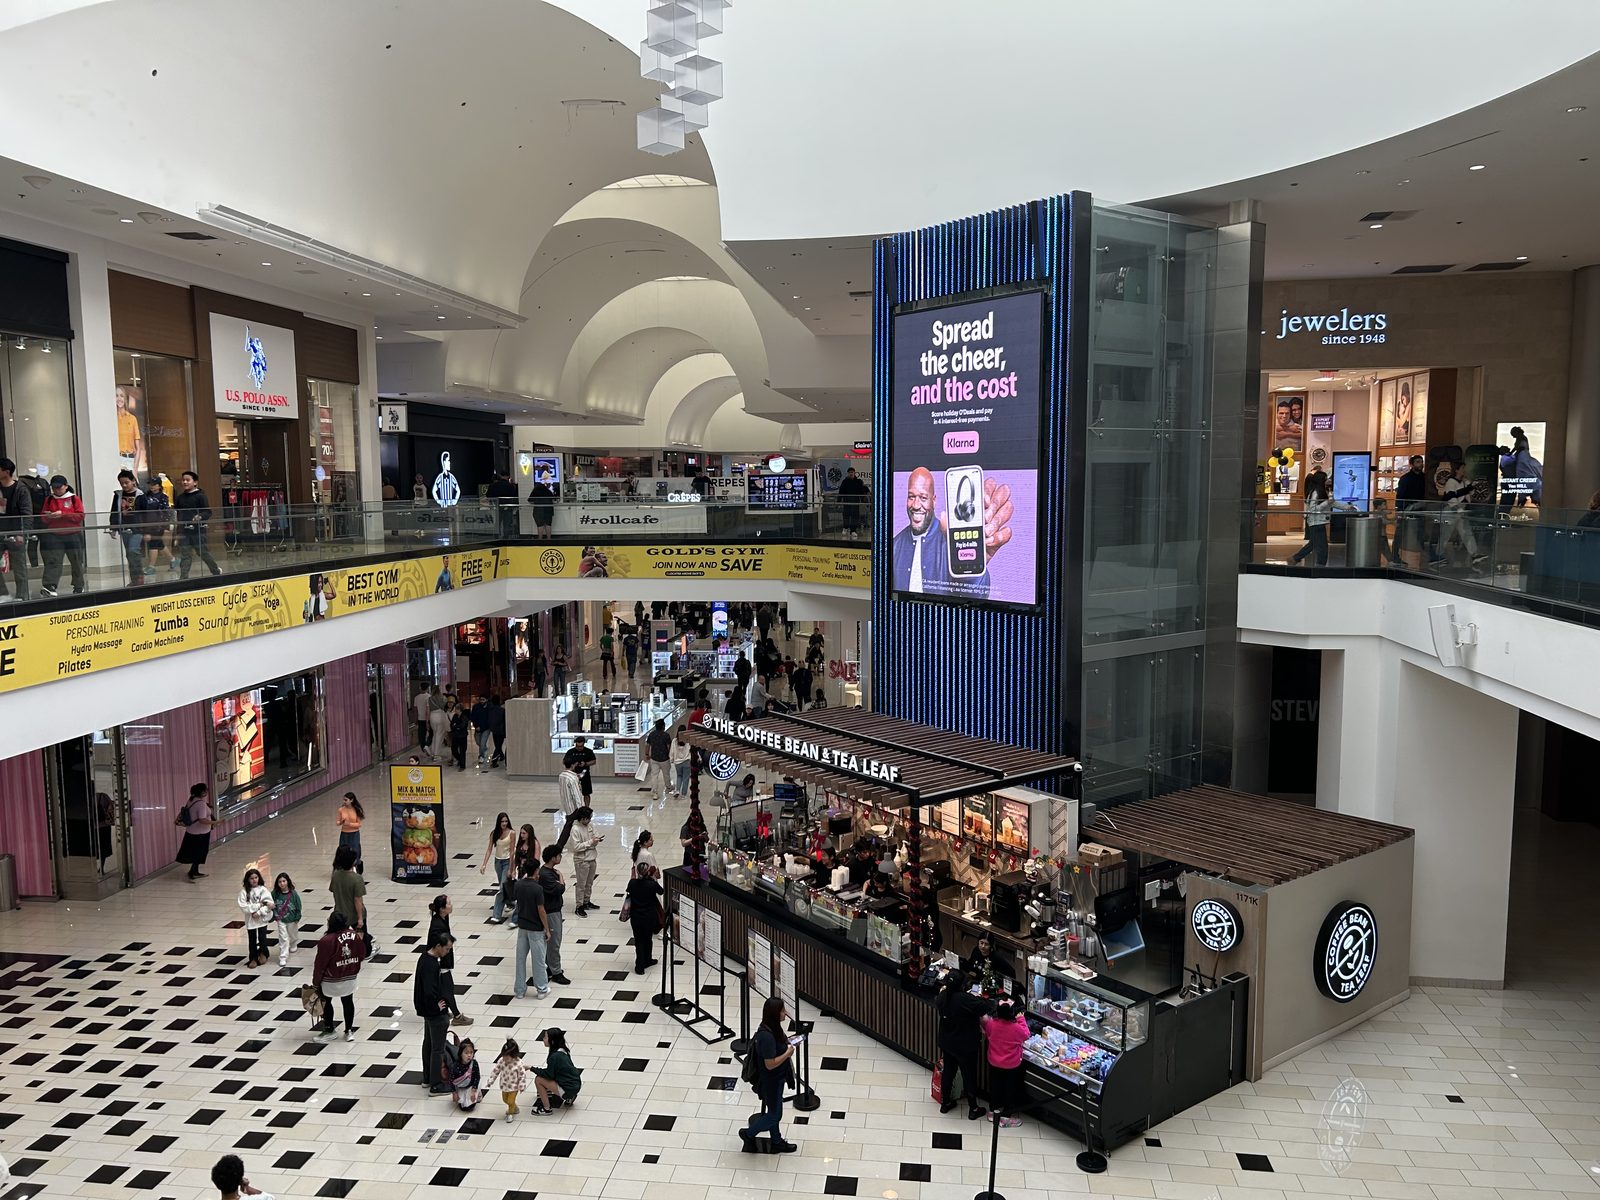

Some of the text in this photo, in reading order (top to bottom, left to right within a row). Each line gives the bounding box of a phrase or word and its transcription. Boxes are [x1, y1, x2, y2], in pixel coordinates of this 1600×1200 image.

[932, 311, 994, 350] Spread
[1276, 308, 1387, 339] jewelers
[1322, 334, 1386, 345] since 1948
[920, 345, 1006, 376] the cheer,
[911, 372, 1018, 405] and the cost
[225, 390, 290, 407] U.S. POLO ASSN.
[242, 404, 260, 412] SINCE
[947, 438, 975, 448] Klarna
[711, 478, 745, 487] REPES
[580, 515, 659, 525] #rollcafe
[647, 547, 765, 555] GOLD'S GYM
[462, 558, 482, 578] FREE
[491, 549, 500, 579] 7
[652, 559, 763, 571] JOIN NOW AND SAVE
[835, 562, 856, 571] Zumba
[348, 569, 398, 591] BEST GYM
[253, 584, 275, 597] STEAM
[348, 587, 399, 607] IN THE WORLD
[151, 596, 215, 613] WEIGHT LOSS CENTER
[223, 589, 247, 610] Cycle
[264, 597, 280, 610] Yoga
[49, 610, 100, 626] STUDIO CLASSES
[154, 615, 189, 633] Zumba
[198, 616, 229, 631] Sauna
[66, 616, 145, 641] PERSONAL TRAINING
[71, 638, 123, 657] Hydro Massage
[131, 634, 184, 653] Cardio Machines
[58, 659, 91, 675] Pilates
[713, 717, 899, 782] THE COFFEE BEAN & TEA LEAF
[1236, 893, 1258, 906] 1171K
[1195, 904, 1229, 923] COFFEE BEAN
[337, 931, 356, 944] EDEN
[1206, 937, 1219, 947] TEA
[1329, 913, 1368, 966] COFFEE BEAN
[1341, 980, 1354, 992] TEA
[1356, 954, 1370, 984] LEAF
